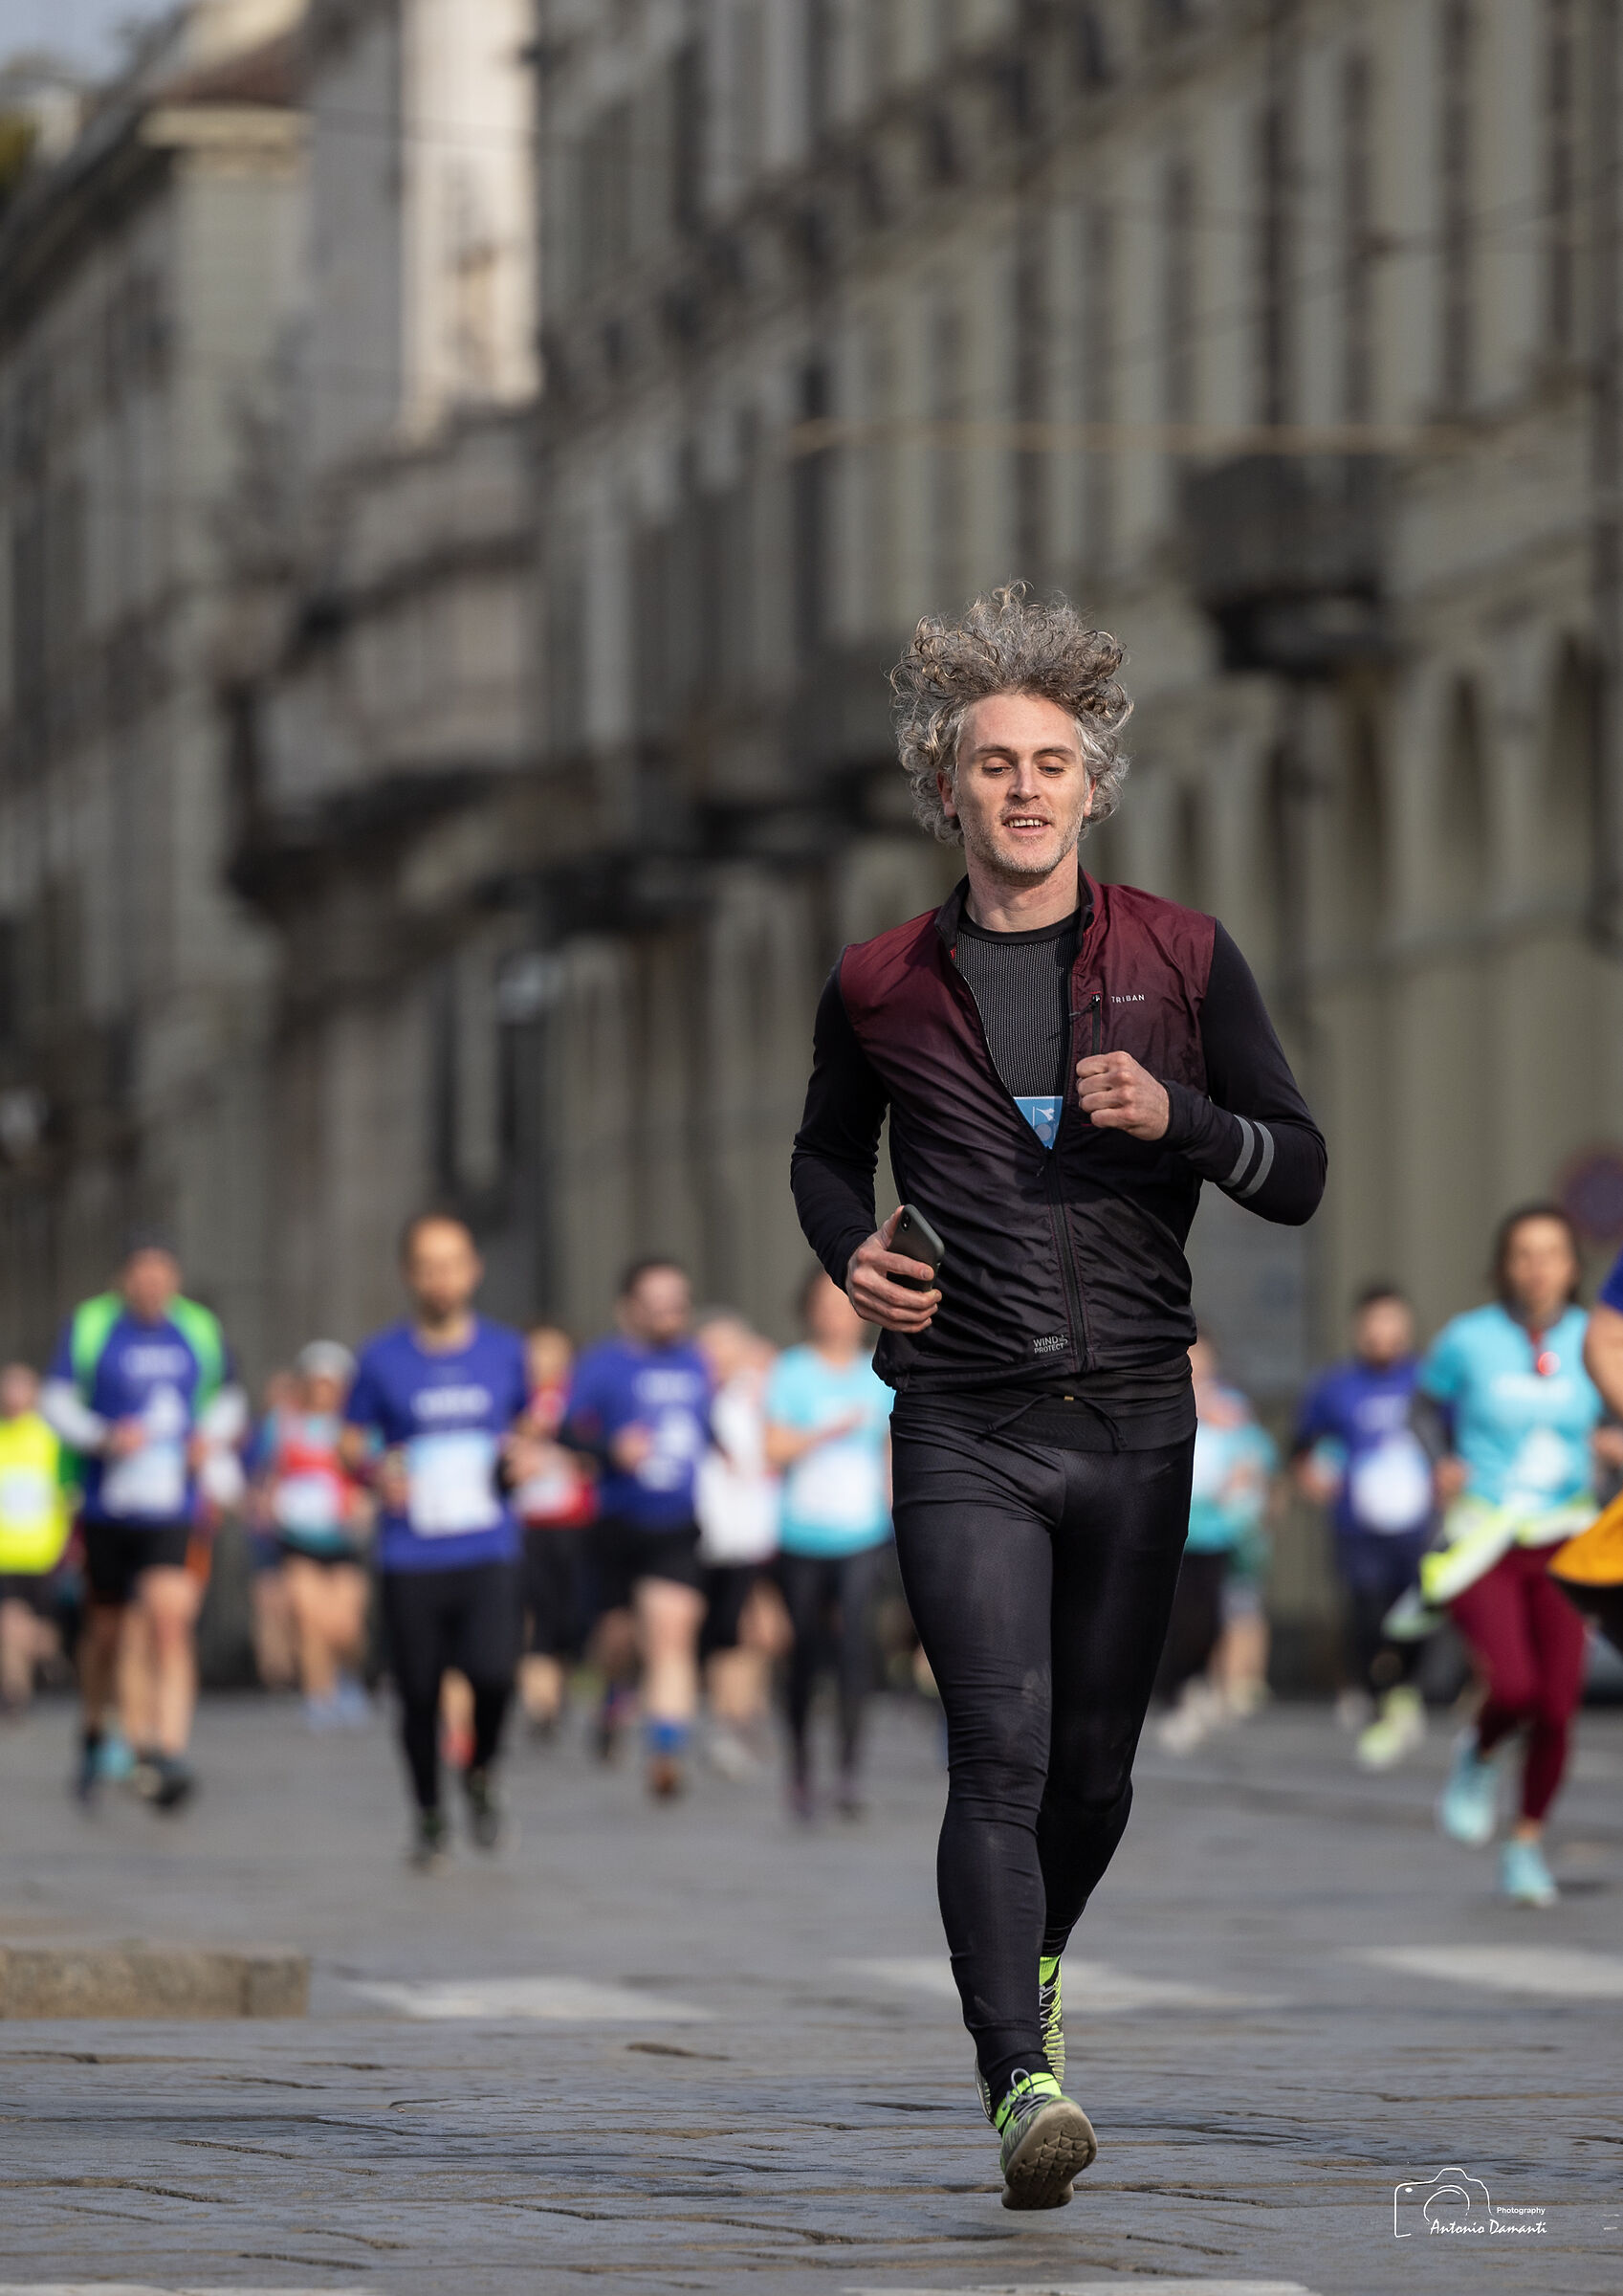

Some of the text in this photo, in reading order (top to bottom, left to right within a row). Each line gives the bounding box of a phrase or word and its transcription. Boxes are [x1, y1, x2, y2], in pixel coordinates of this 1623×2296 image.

[1111, 994, 1145, 1003] TRIBAN
[1033, 1336, 1059, 1348] WIND
[1034, 1342, 1064, 1354] PROTECT
